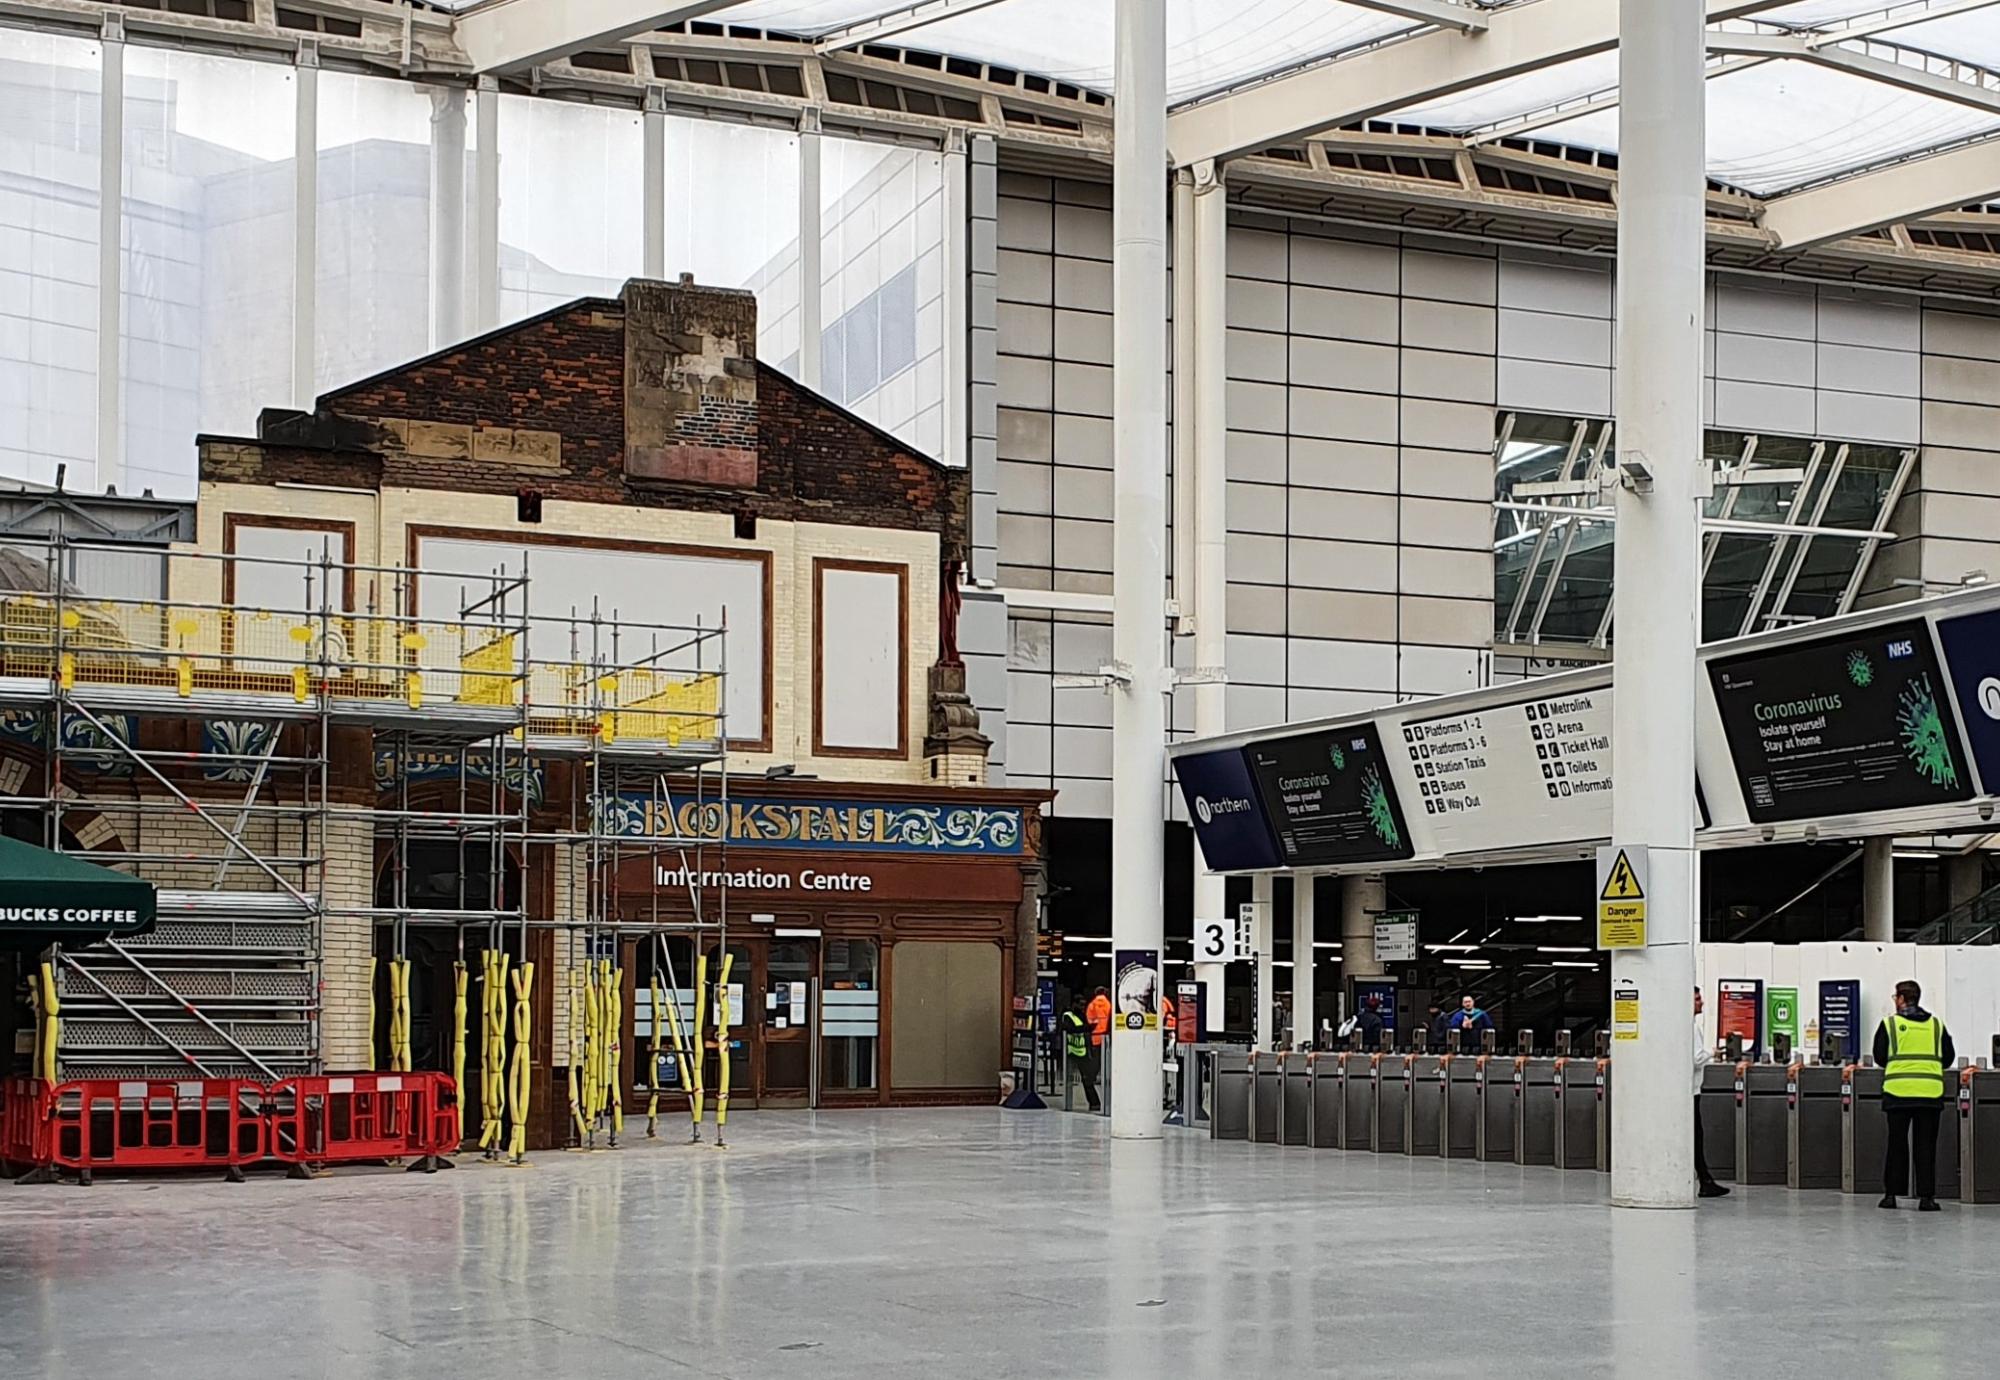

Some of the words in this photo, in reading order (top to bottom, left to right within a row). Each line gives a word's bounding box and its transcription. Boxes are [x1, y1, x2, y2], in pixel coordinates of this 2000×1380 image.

[1888, 640, 1913, 658] NHS
[1550, 697, 1593, 716] Metrolink
[1754, 693, 1842, 721] Coronavirus
[1424, 722, 1463, 738] Platforms
[1464, 718, 1470, 731] 1
[1475, 717, 1482, 730] 2
[1556, 721, 1584, 736] Arena
[1759, 723, 1788, 738] Isolate
[1790, 716, 1827, 735] yourself
[1430, 740, 1468, 756] Platforms
[1468, 737, 1475, 750] 3
[1480, 736, 1488, 749] 6
[1560, 739, 1590, 755] Ticket
[1590, 736, 1610, 751] Hall
[1763, 740, 1784, 753] Stay
[1785, 738, 1794, 749] at
[1795, 734, 1822, 747] home
[1436, 760, 1464, 775] Station
[1464, 756, 1486, 770] Taxis
[1566, 759, 1598, 774] Toilets
[1279, 772, 1330, 791] Coronavirus
[1441, 778, 1466, 793] Buses
[1572, 776, 1613, 795] Informati
[1210, 796, 1251, 813] northern
[1447, 797, 1465, 812] Way
[1465, 795, 1481, 809] Out
[644, 799, 900, 844] BOOKSTALL
[657, 866, 791, 889] Information
[799, 869, 873, 891] Centre
[63, 908, 137, 923] COFFEE
[1607, 907, 1637, 918] Danger
[1204, 924, 1225, 956] 3
